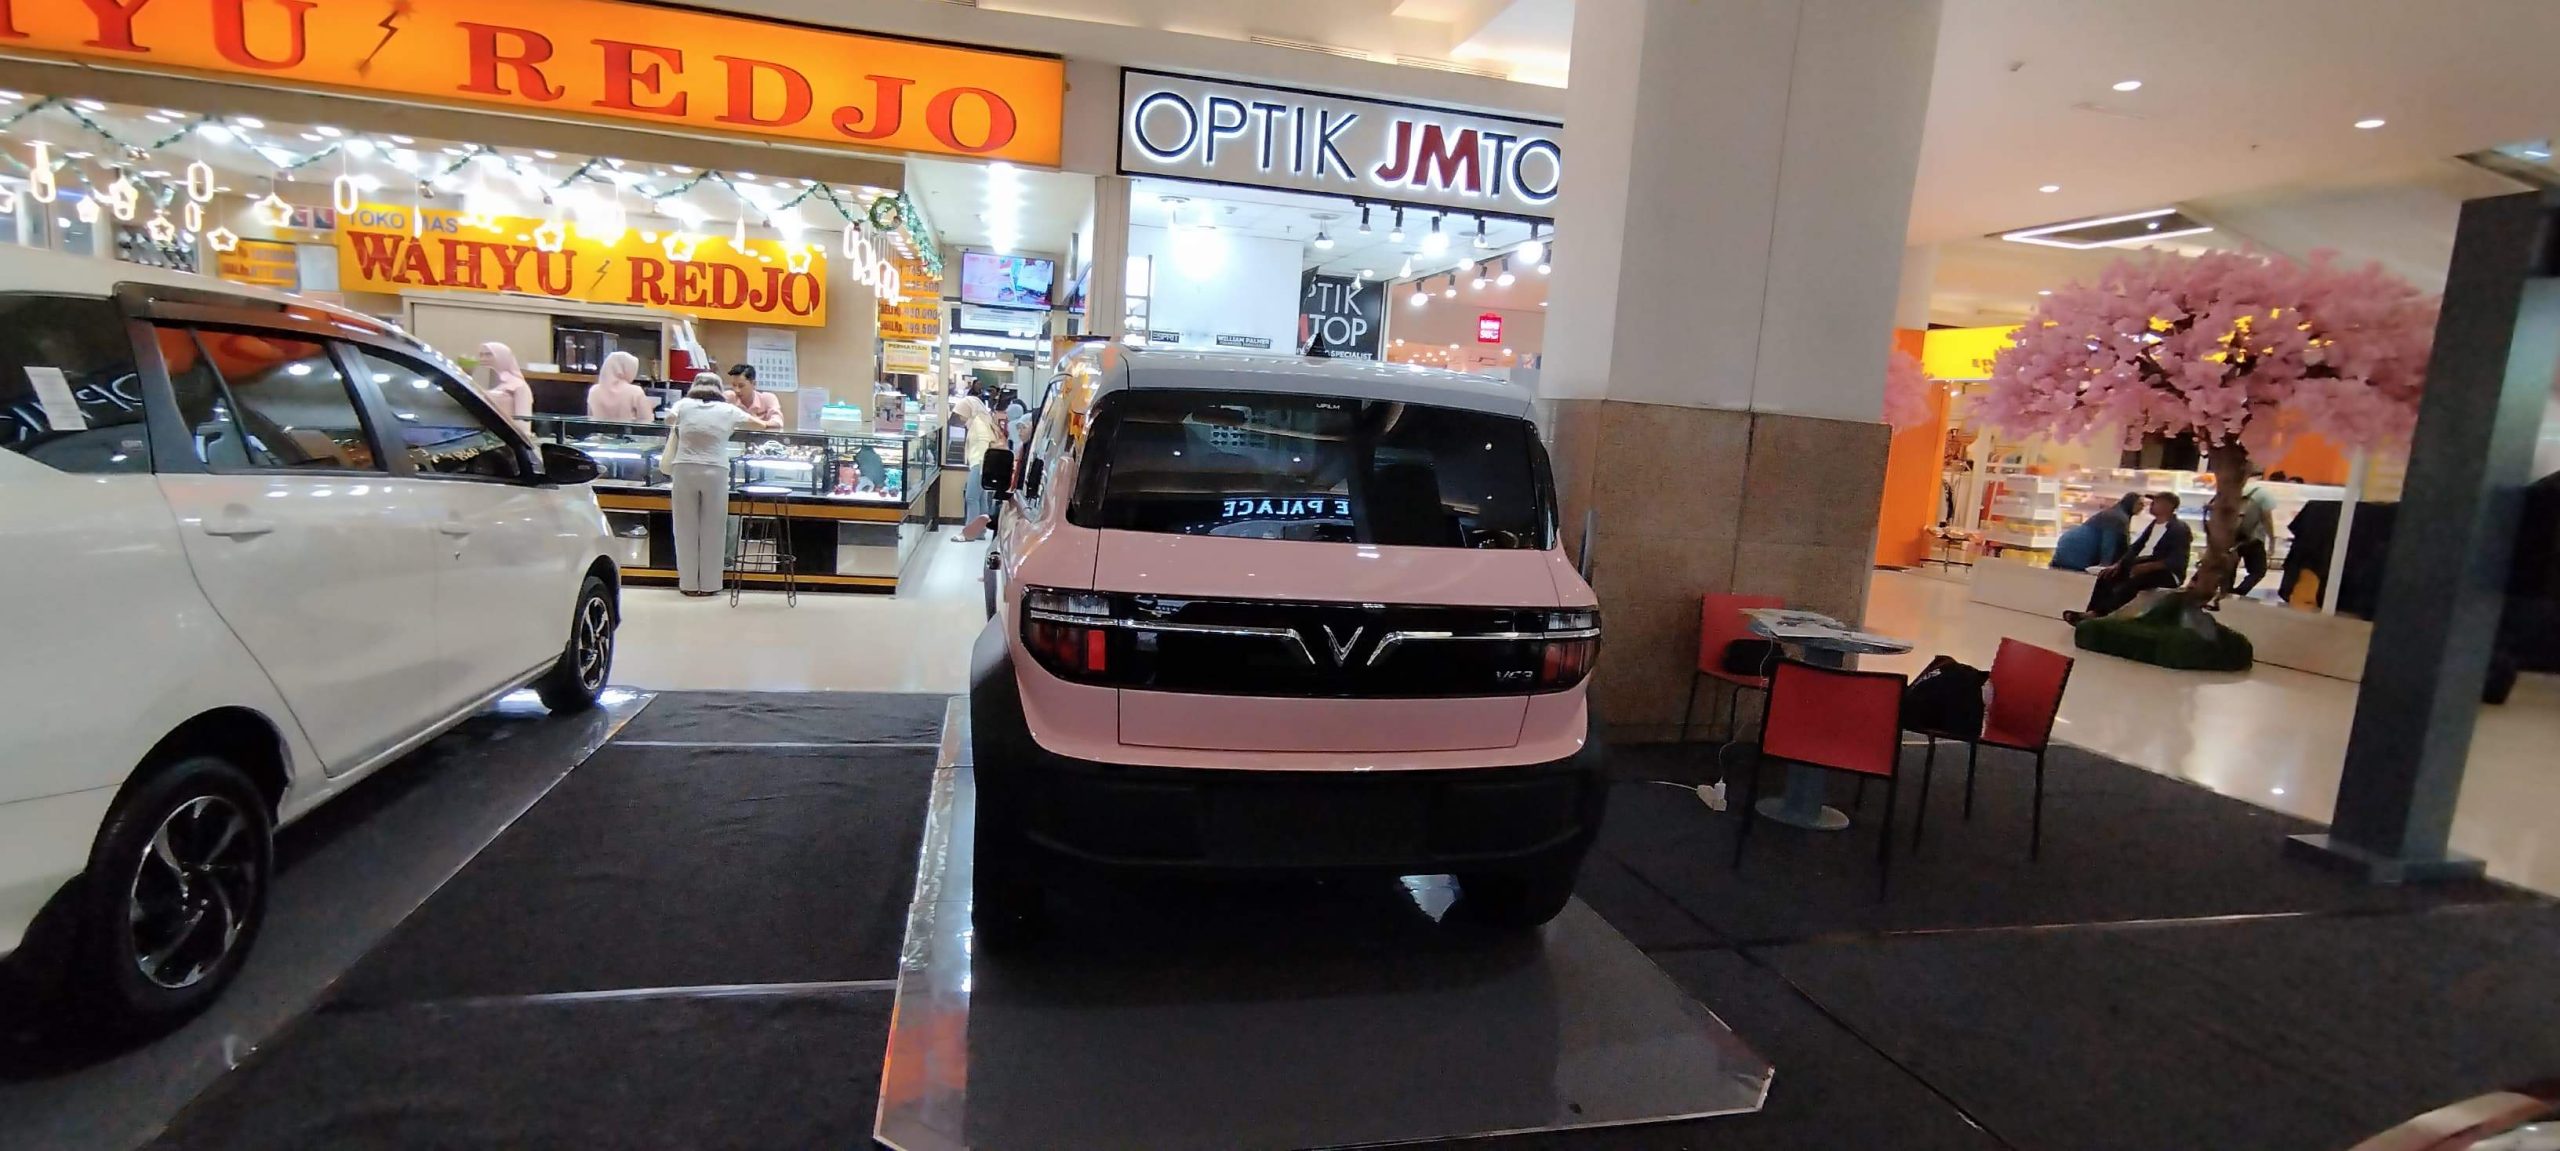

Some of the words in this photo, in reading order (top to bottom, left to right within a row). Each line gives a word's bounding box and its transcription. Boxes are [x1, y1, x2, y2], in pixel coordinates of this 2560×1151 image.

[0, 0, 317, 69] YU
[456, 21, 1017, 153] REDJO
[1134, 91, 1359, 179] OPTIK
[347, 230, 577, 297] WAHYU
[626, 255, 820, 316] REDJO
[1308, 277, 1364, 315] TIK
